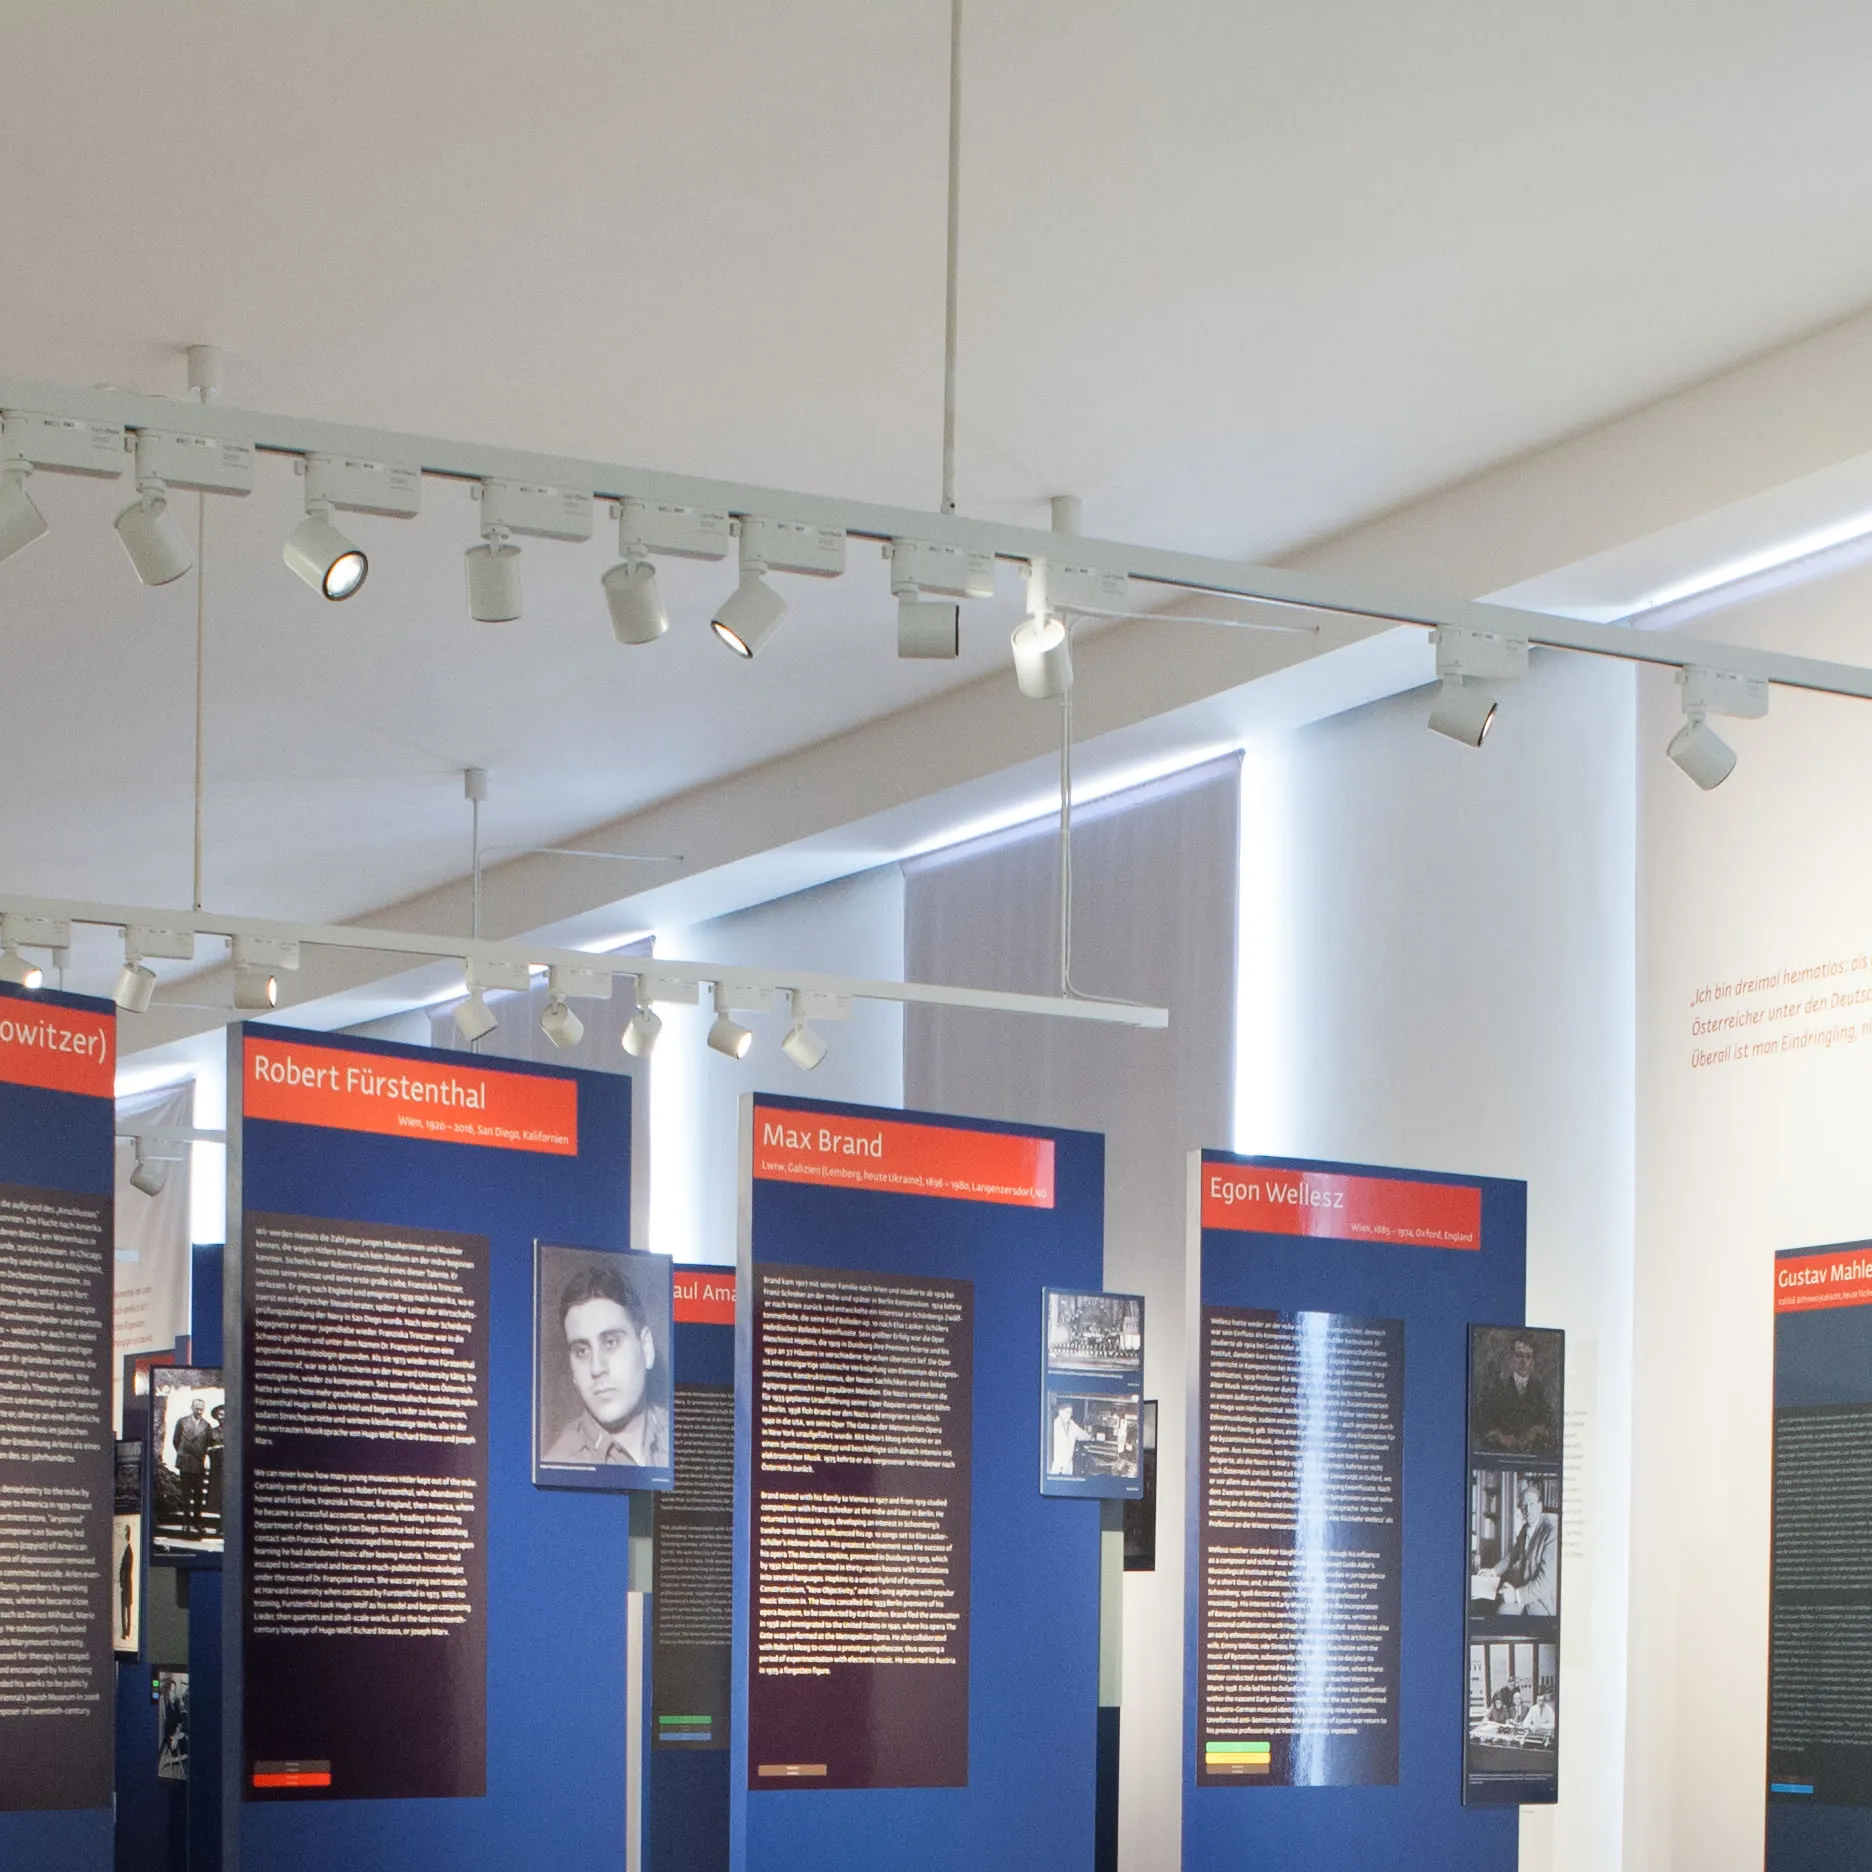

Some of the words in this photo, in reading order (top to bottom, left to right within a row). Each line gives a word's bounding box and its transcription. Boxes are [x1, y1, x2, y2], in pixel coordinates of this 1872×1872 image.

[1713, 981, 1732, 1000] bin
[1734, 972, 1780, 996] dreimal
[1782, 959, 1849, 985] heimatlos:
[1851, 955, 1868, 972] als
[1691, 1009, 1766, 1037] Österreicher
[1767, 1002, 1802, 1022] unter
[1804, 997, 1827, 1014] den
[1690, 1043, 1732, 1069] Überall
[1732, 1043, 1749, 1060] ist
[1751, 1040, 1779, 1057] man
[1780, 1024, 1859, 1052] Eindringling,
[255, 1054, 340, 1091] Robert
[346, 1067, 485, 1110] Fürstenthal
[397, 1114, 424, 1130] Wien,
[425, 1119, 447, 1131] 1920
[453, 1123, 476, 1136] 2016,
[476, 1124, 494, 1136] San
[494, 1126, 521, 1142] Diego,
[522, 1130, 569, 1145] Kalifornien
[762, 1122, 812, 1150] Max
[818, 1128, 882, 1158] Brand
[1210, 1176, 1260, 1205] Egon
[1265, 1182, 1343, 1208] Wellesz
[1352, 1222, 1373, 1234] Wien,
[1373, 1224, 1391, 1237] 1885
[1396, 1227, 1415, 1238] 1974,
[1414, 1228, 1443, 1241] Oxford,
[1443, 1230, 1473, 1243] England
[673, 1280, 698, 1299] aul
[1777, 1267, 1828, 1288] Gustav
